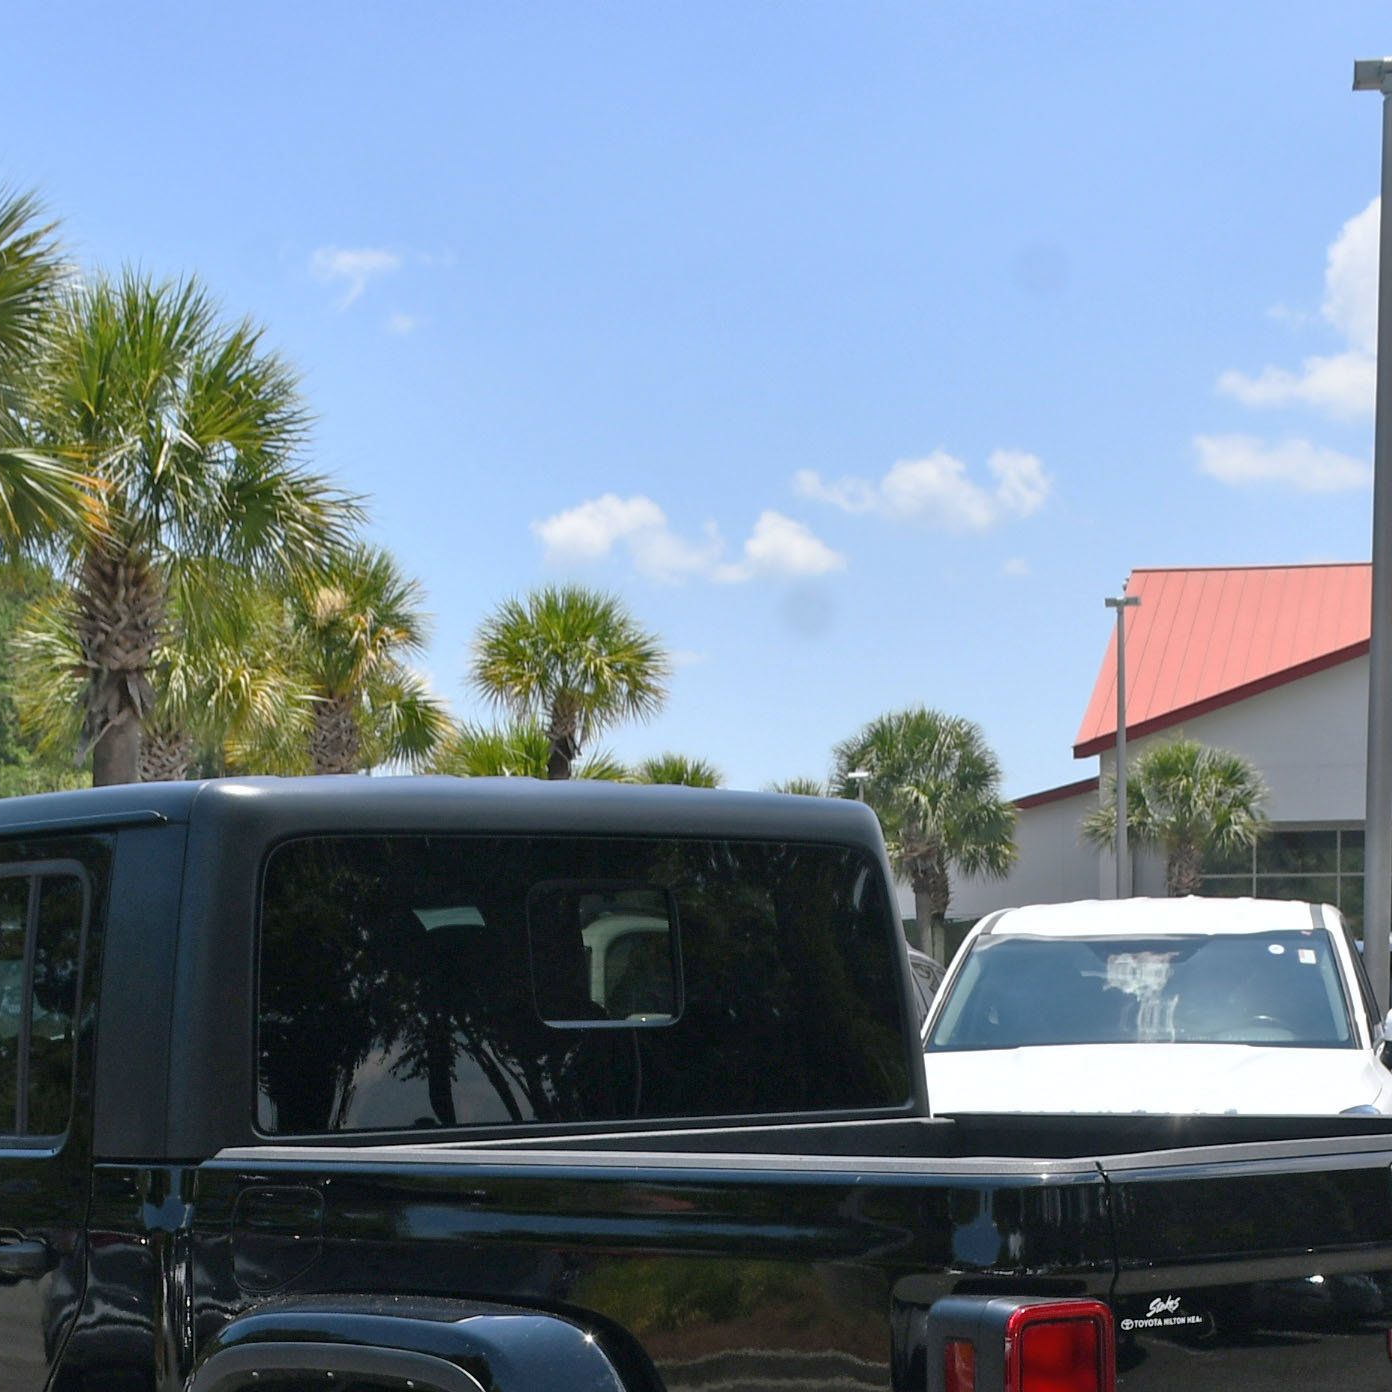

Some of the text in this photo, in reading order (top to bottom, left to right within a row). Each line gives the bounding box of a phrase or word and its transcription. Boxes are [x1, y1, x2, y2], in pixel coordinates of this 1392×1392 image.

[1146, 1295, 1181, 1317] Stokes
[1134, 1318, 1163, 1328] TOYOTA
[1164, 1316, 1186, 1326] HILTON
